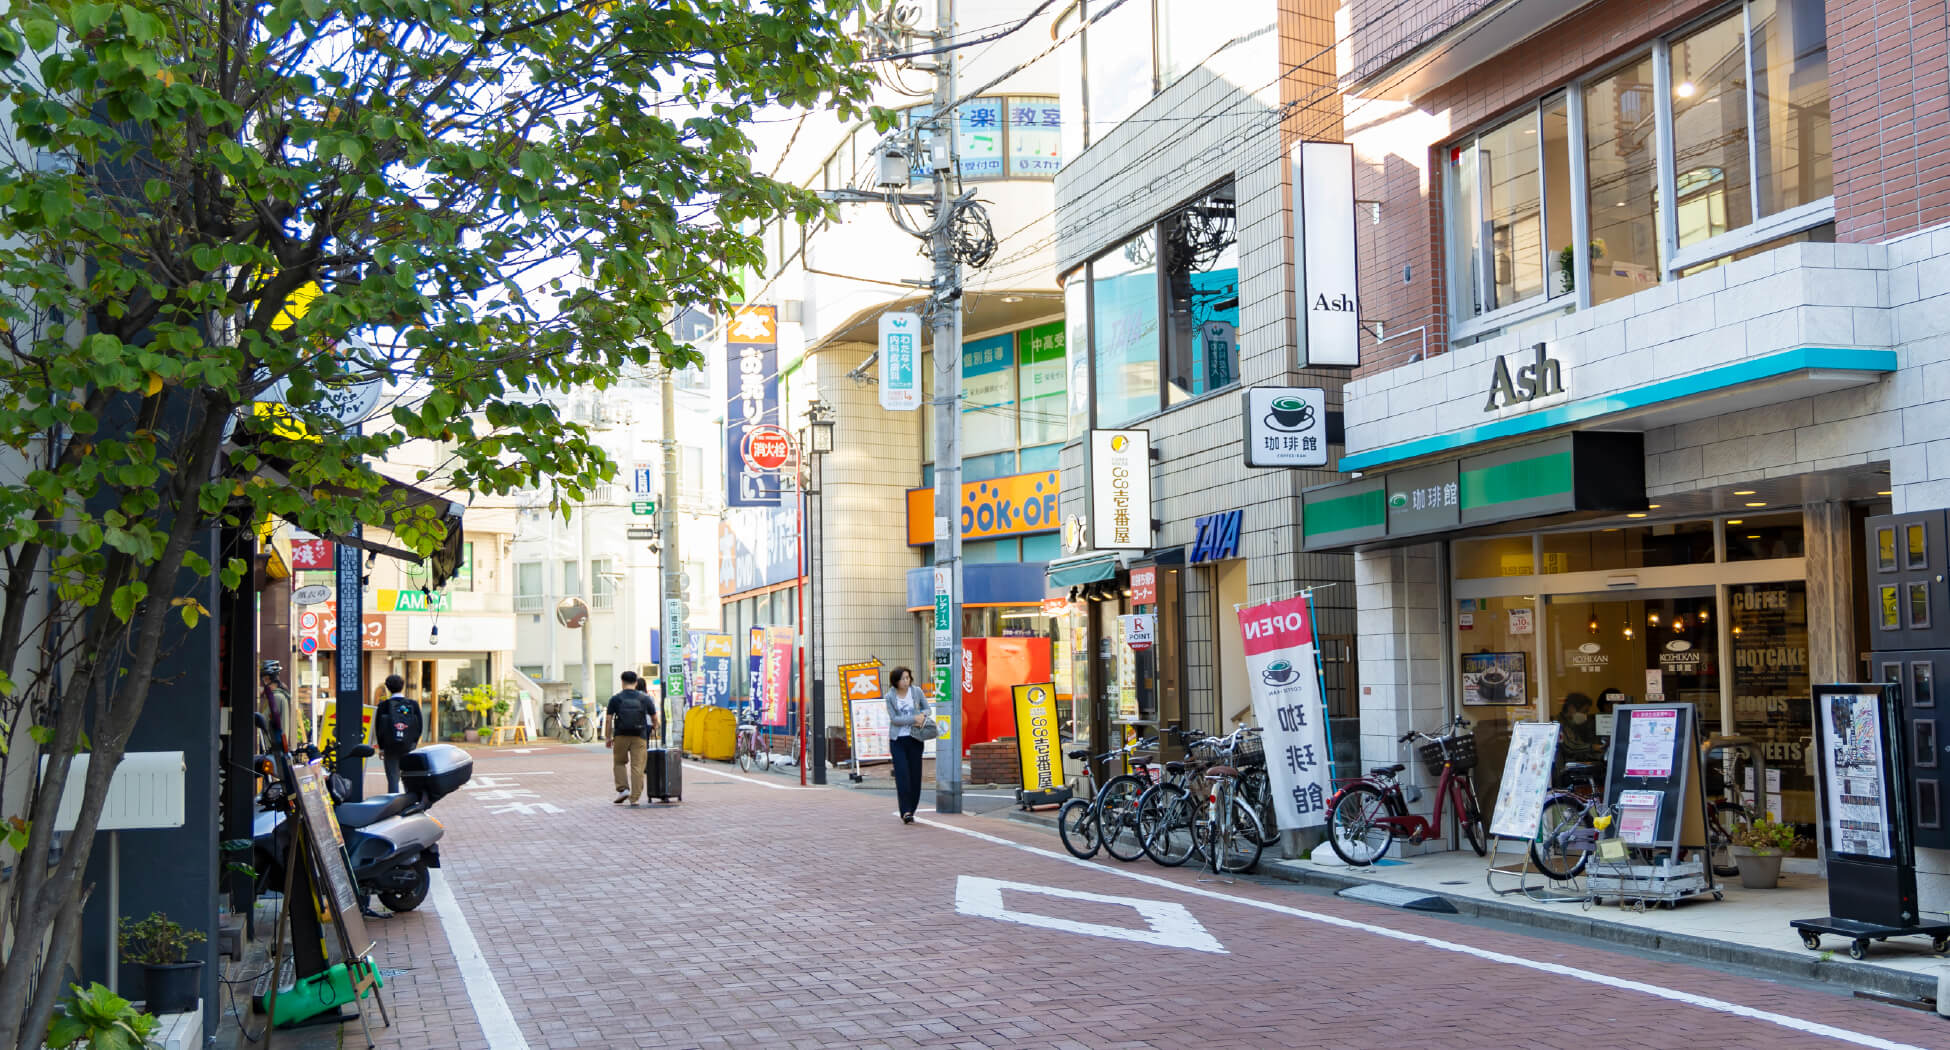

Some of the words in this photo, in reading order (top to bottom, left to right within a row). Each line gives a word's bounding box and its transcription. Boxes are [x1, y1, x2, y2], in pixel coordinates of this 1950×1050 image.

[1313, 292, 1356, 313] Ash
[733, 311, 771, 340] 本
[1484, 342, 1566, 413] Ash
[739, 347, 767, 499] お売りい
[754, 442, 786, 458] 消火栓
[1264, 436, 1318, 451] 珈琲館
[1412, 482, 1458, 511] 珈琲館
[1189, 509, 1244, 563] TAYA
[400, 593, 449, 609] AMICA
[1133, 587, 1153, 600] コーナー
[1733, 590, 1788, 611] COFFEE
[1735, 646, 1808, 668] HOTCAKE
[671, 679, 682, 693] 文
[849, 673, 879, 695] 本
